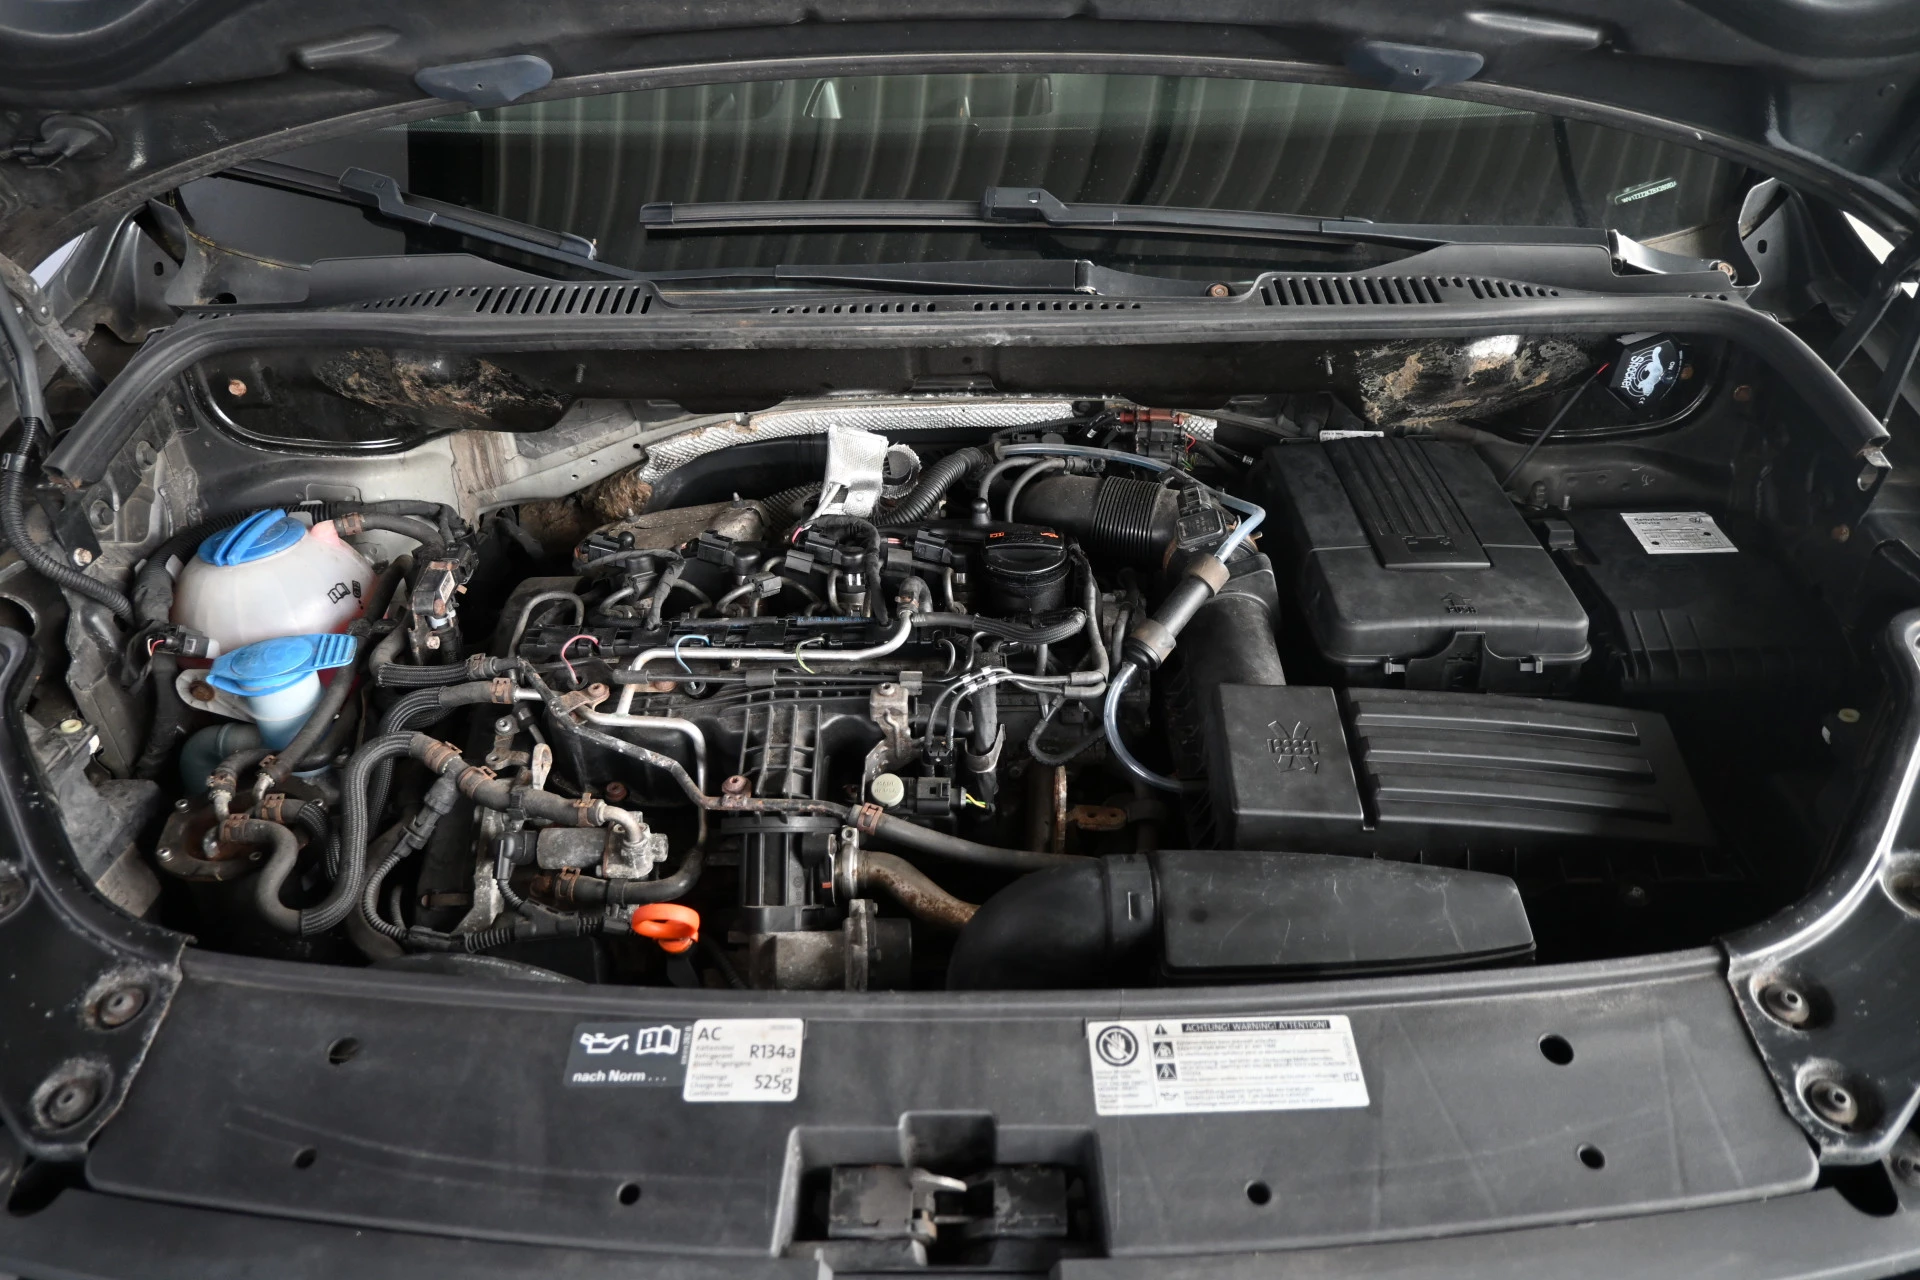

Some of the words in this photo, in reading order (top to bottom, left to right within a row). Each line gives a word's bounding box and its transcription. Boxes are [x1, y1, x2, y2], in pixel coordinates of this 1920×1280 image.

[1620, 355, 1645, 390] Shocker
[1184, 1022, 1231, 1032] ACHTUNG!
[1232, 1021, 1277, 1032] WARNING!
[1278, 1020, 1328, 1031] ATTENTION!
[698, 1027, 723, 1041] AC
[750, 1045, 796, 1060] R134a
[572, 1070, 606, 1082] nach
[754, 1075, 793, 1094] 525g
